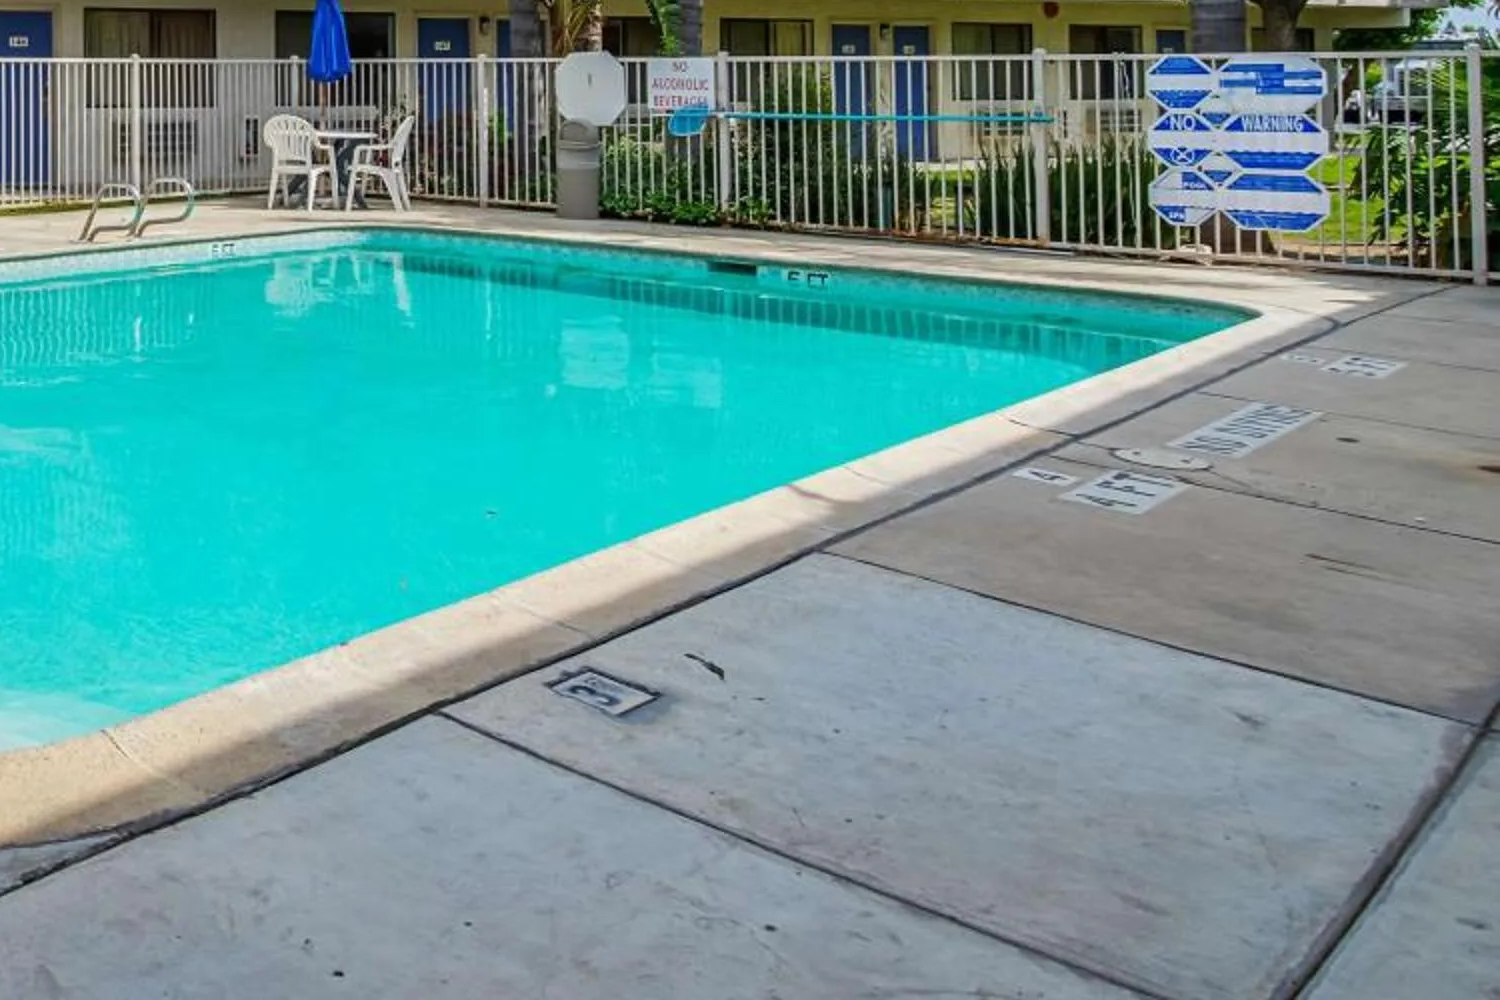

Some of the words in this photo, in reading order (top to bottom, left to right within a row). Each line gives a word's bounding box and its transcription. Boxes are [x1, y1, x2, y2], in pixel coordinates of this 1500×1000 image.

[672, 60, 689, 73] NO
[652, 77, 709, 90] ALCOHOLIC
[1169, 115, 1196, 131] NO
[1241, 115, 1304, 132] WARNING
